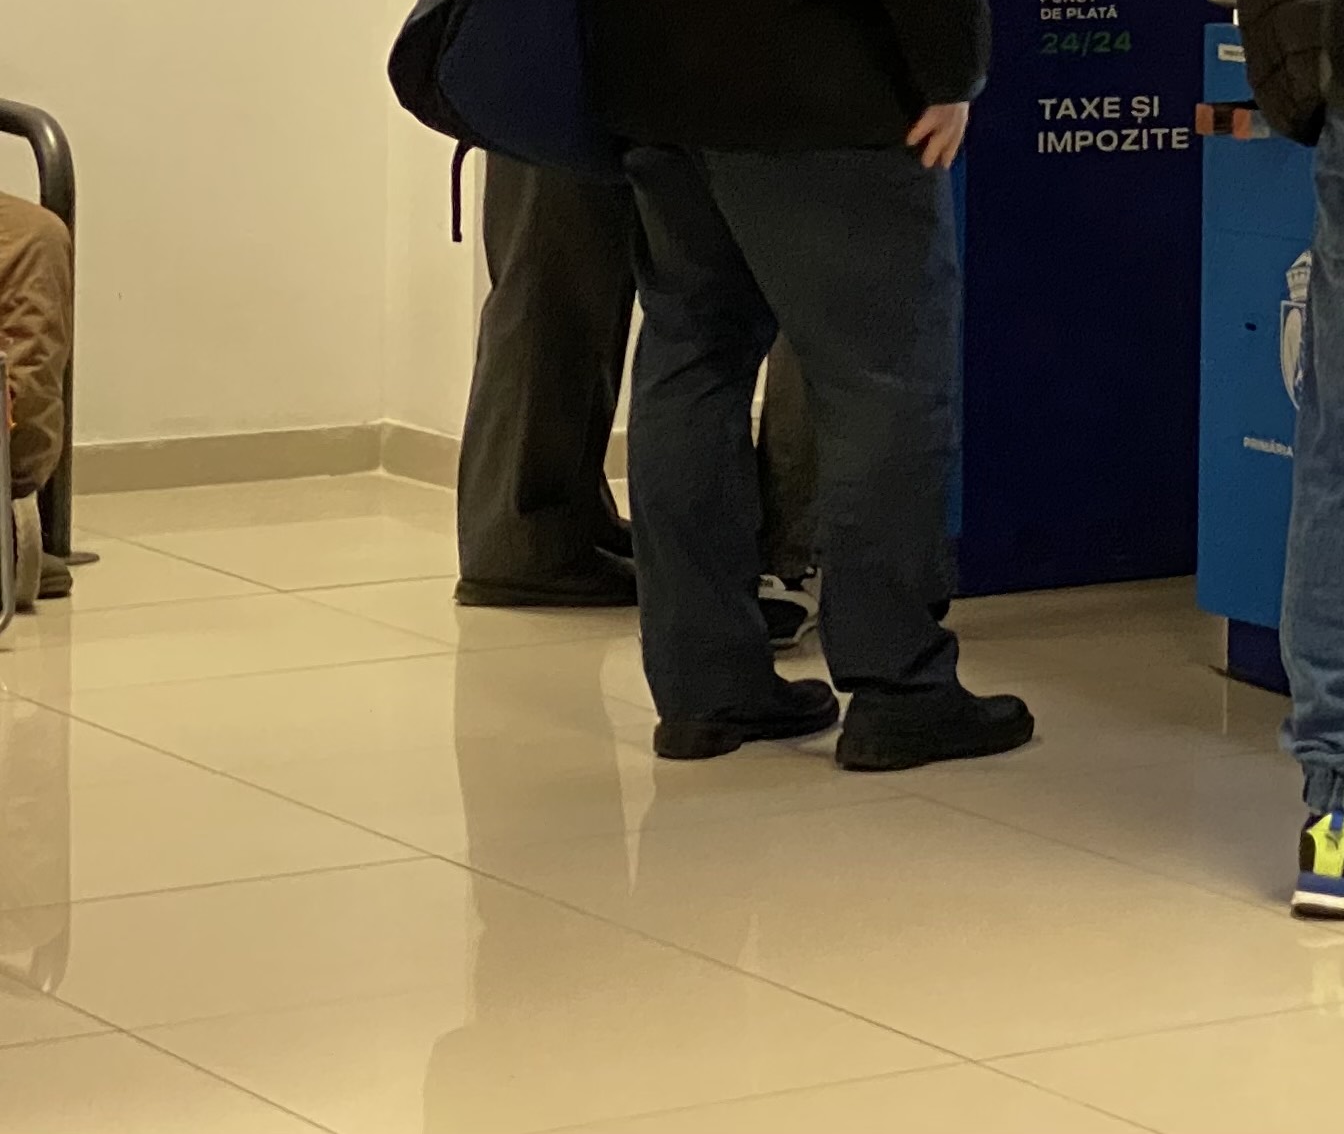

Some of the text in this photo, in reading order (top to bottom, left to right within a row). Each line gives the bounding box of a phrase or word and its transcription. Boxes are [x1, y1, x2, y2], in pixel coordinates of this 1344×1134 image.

[1040, 4, 1118, 20] DE PLATĂ
[1040, 31, 1132, 56] 24/24
[1038, 96, 1159, 123] TAXE ȘI
[1038, 127, 1190, 153] IMPOZITE
